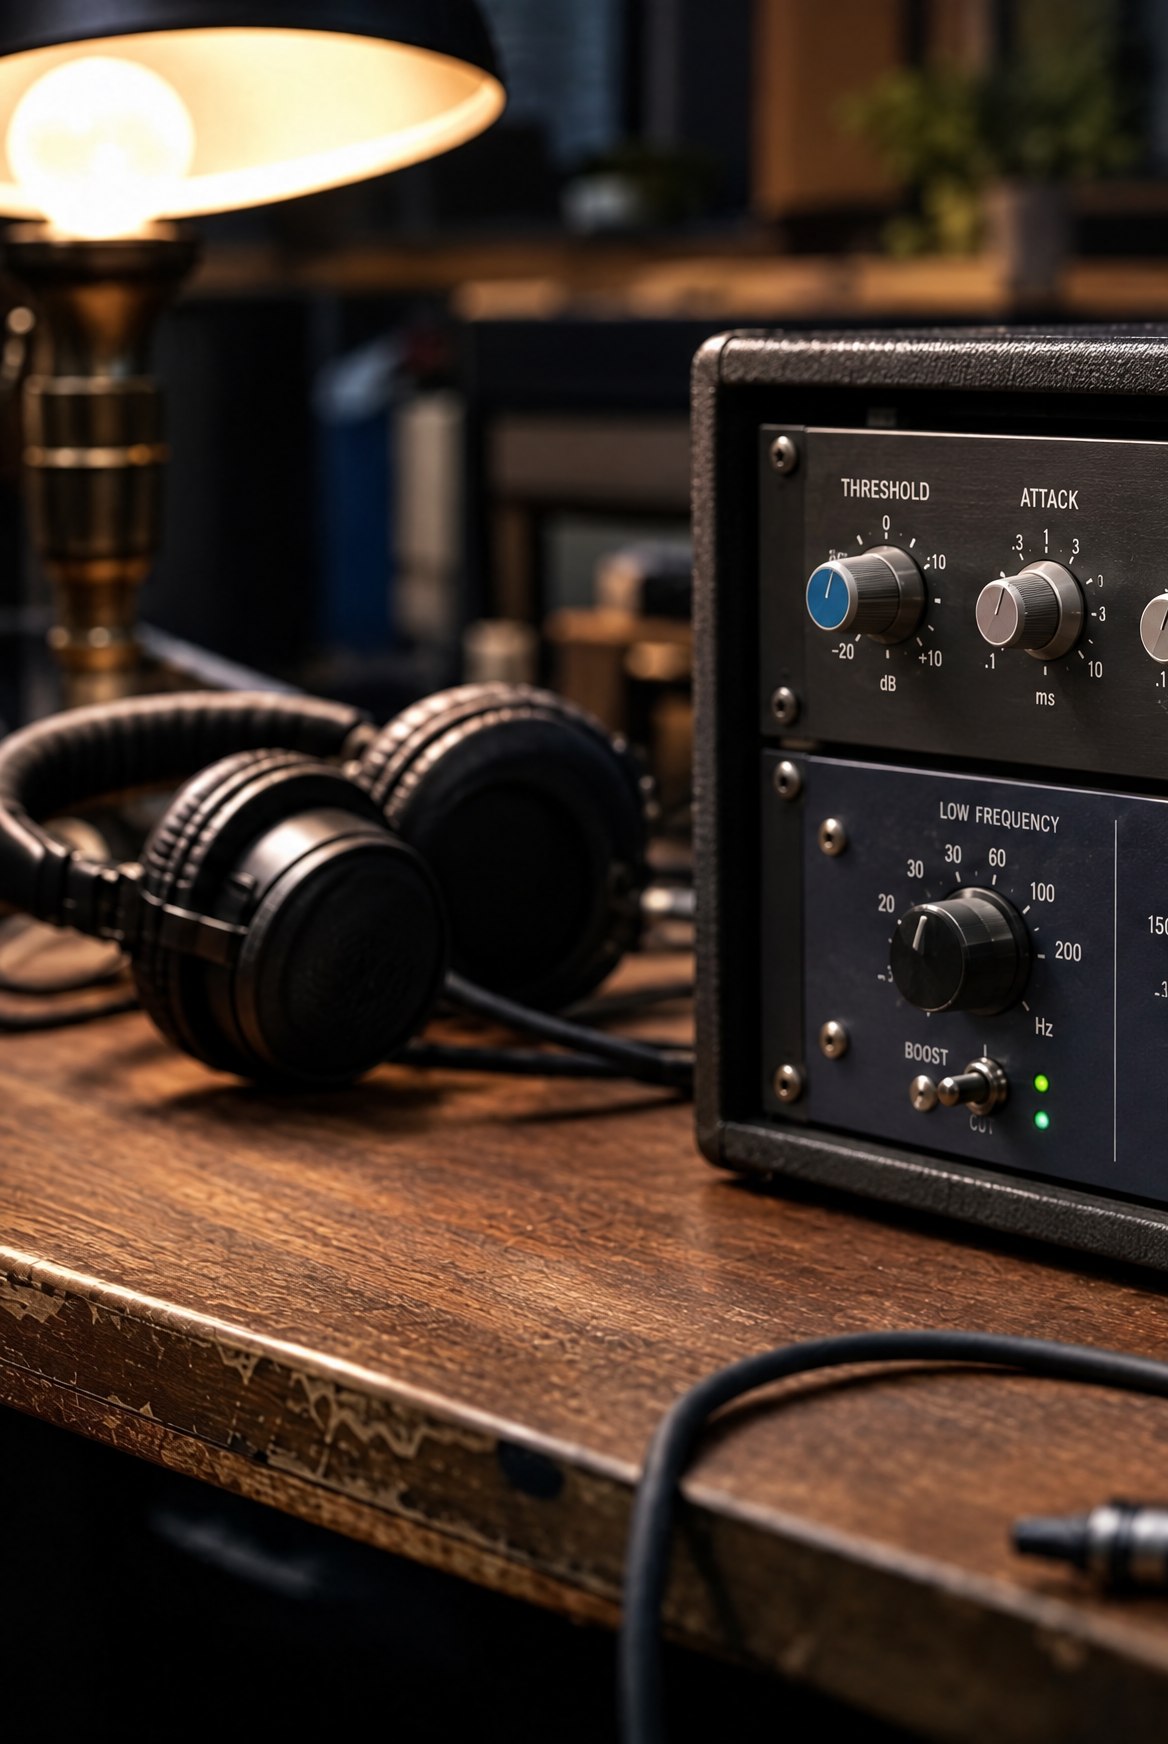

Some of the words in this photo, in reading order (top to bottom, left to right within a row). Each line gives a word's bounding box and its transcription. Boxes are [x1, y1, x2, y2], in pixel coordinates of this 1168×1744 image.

[841, 479, 929, 500] THRESHOLD
[1021, 488, 1078, 509] ATTACK
[883, 515, 890, 530] 0
[1012, 534, 1023, 550] .3
[1044, 529, 1048, 544] 1
[1072, 539, 1079, 554] 3
[832, 643, 854, 659] -20
[919, 650, 942, 666] +10
[1089, 661, 1102, 678] 10
[880, 675, 896, 691] dB
[1036, 692, 1055, 706] ms
[940, 802, 969, 821] LOW
[976, 806, 1059, 833] FREQUENCY
[945, 844, 961, 863] 30
[989, 848, 1005, 867] 60
[907, 859, 923, 878] 30
[1031, 882, 1054, 902] 100
[879, 894, 894, 913] 20
[1056, 941, 1081, 961] 200
[1036, 1017, 1053, 1037] Hz
[905, 1042, 948, 1065] BOOST
